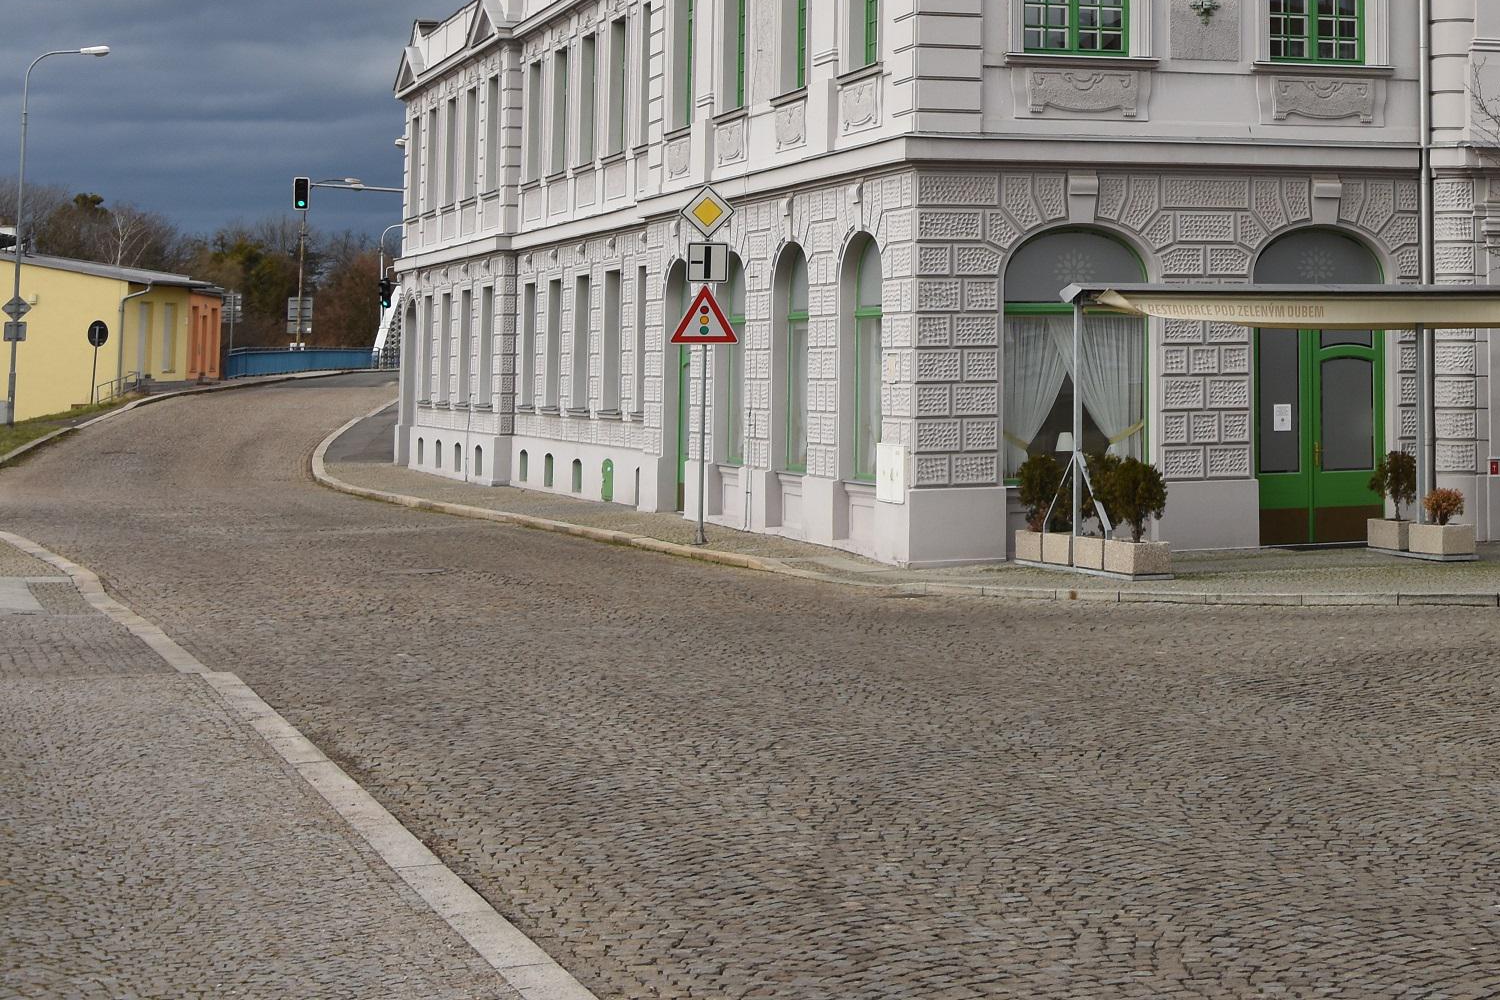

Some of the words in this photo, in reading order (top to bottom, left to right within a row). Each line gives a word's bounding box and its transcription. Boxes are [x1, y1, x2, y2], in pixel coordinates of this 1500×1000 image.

[1148, 303, 1213, 316] RESTAURACE
[1214, 304, 1236, 316] POD
[1237, 302, 1285, 317] ZELENÝM
[1287, 304, 1325, 318] DUBEM
